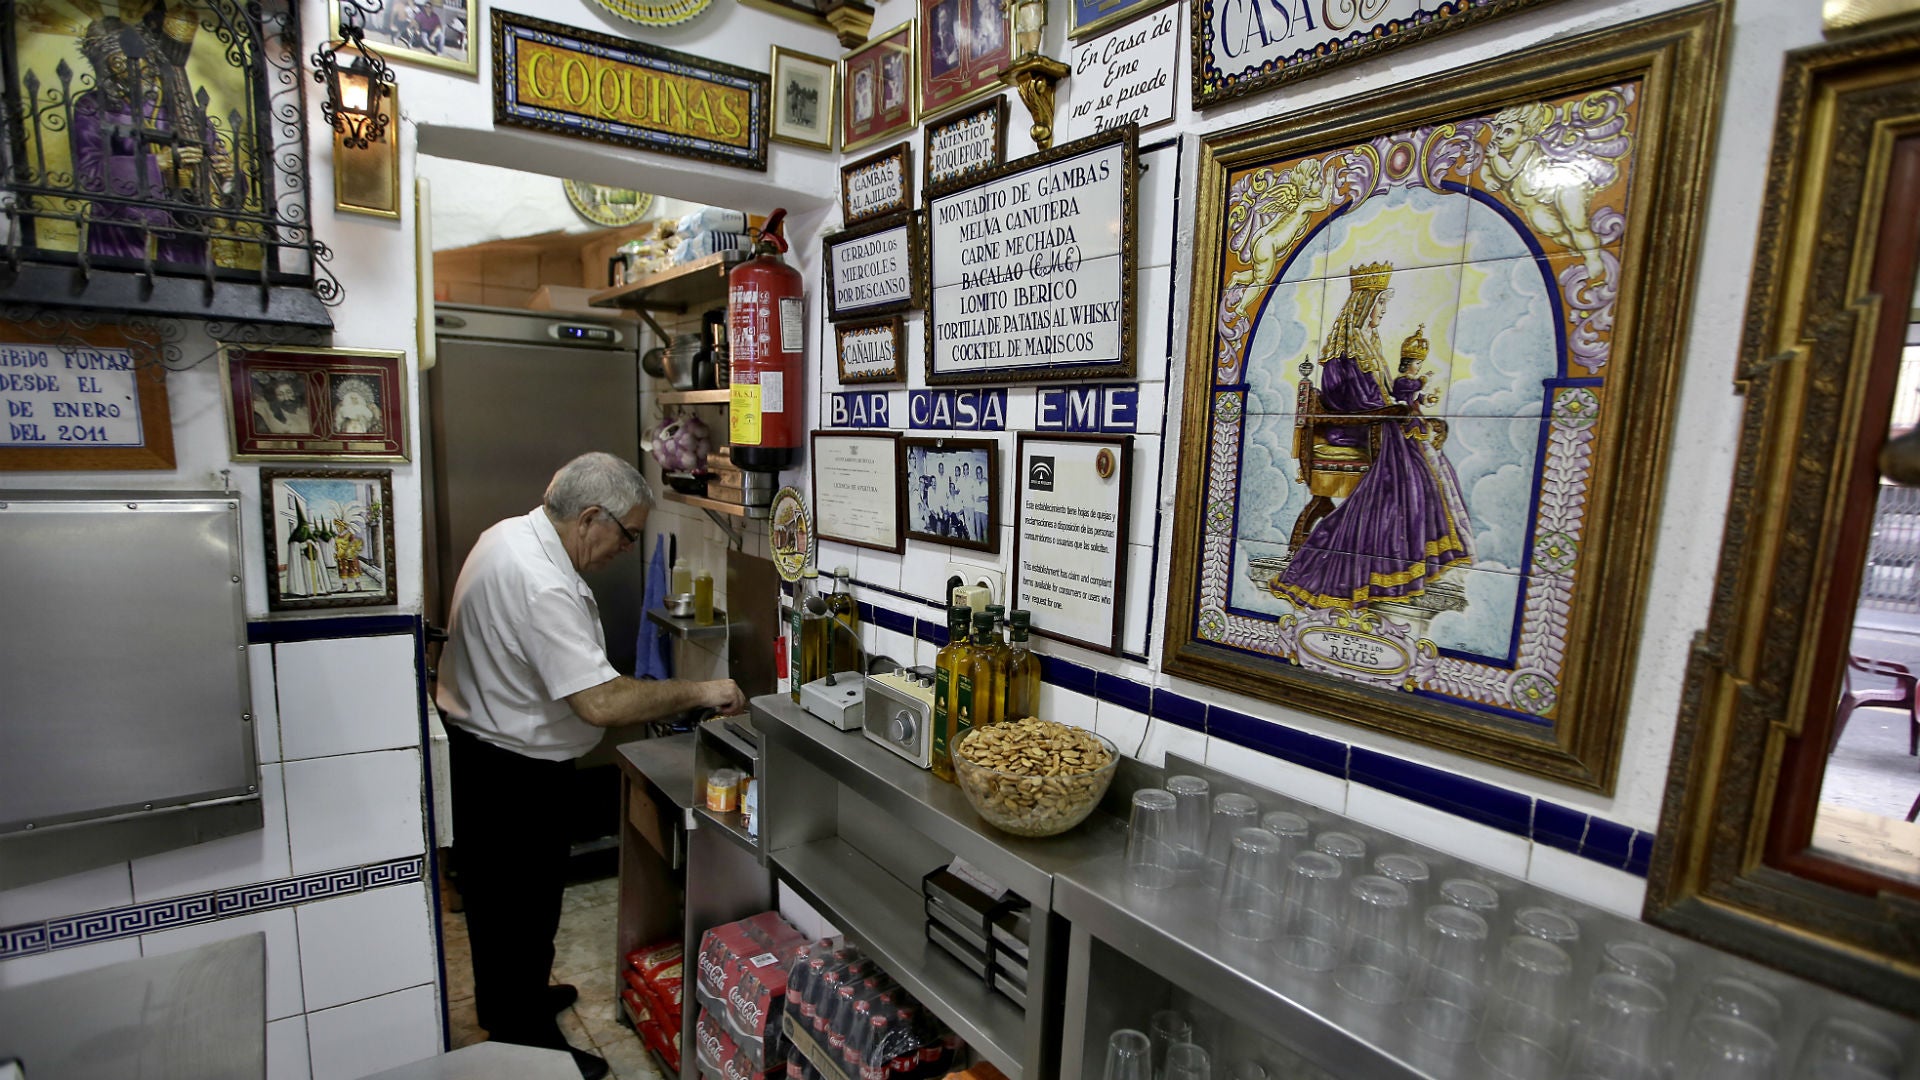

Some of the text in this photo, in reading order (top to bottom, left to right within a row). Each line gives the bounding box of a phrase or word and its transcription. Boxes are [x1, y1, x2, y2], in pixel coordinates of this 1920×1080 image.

[1077, 14, 1173, 75] En Casa de
[1103, 59, 1139, 89] Eme
[527, 51, 742, 139] COQUINAS
[1072, 68, 1167, 119] no se puede
[937, 124, 985, 151] AUTENTICO
[935, 138, 990, 172] ROQUEFORT
[854, 167, 894, 191] GAMBAS
[939, 159, 1110, 225] MONTADITO DE GAMBAS
[852, 185, 898, 211] AL AJILLOS
[960, 196, 1080, 243] MELVA CANUTERA
[841, 239, 898, 263] CERRADO LOS
[962, 225, 1077, 266] CARNE MECHADA
[842, 257, 898, 283] MIERCOLES
[962, 262, 1024, 290] BACALAO
[838, 277, 905, 304] POR DESCANSO
[960, 279, 1077, 315] LOMITO IBERICO
[937, 301, 1120, 341] TORTILLA DE PATATAS AL WHISKY
[845, 340, 892, 365] CAÑAILLAS
[952, 332, 1094, 362] COCKTEL DE MARISCOS
[65, 352, 131, 371] FUMAR
[0, 373, 102, 393] DESDE EL
[7, 400, 121, 418] DE ENERO
[833, 387, 1135, 428] BAR CASA EME
[9, 422, 109, 441] DEL 2011
[1025, 500, 1035, 509] Este
[1035, 501, 1066, 514] establecimiento
[1078, 507, 1089, 518] hojas
[1090, 509, 1096, 518] de
[1097, 511, 1112, 521] quejas
[1081, 524, 1087, 533] de
[1094, 528, 1115, 538] personas
[1074, 541, 1083, 550] que
[1023, 561, 1113, 588] This establishment has claim and complaint
[1022, 593, 1030, 604] may
[1031, 595, 1047, 607] request
[1034, 579, 1051, 591] available
[1058, 586, 1082, 598] consumers
[1082, 591, 1087, 599] or
[1087, 593, 1101, 603] users
[1101, 595, 1111, 605] who
[1329, 645, 1379, 665] REYES
